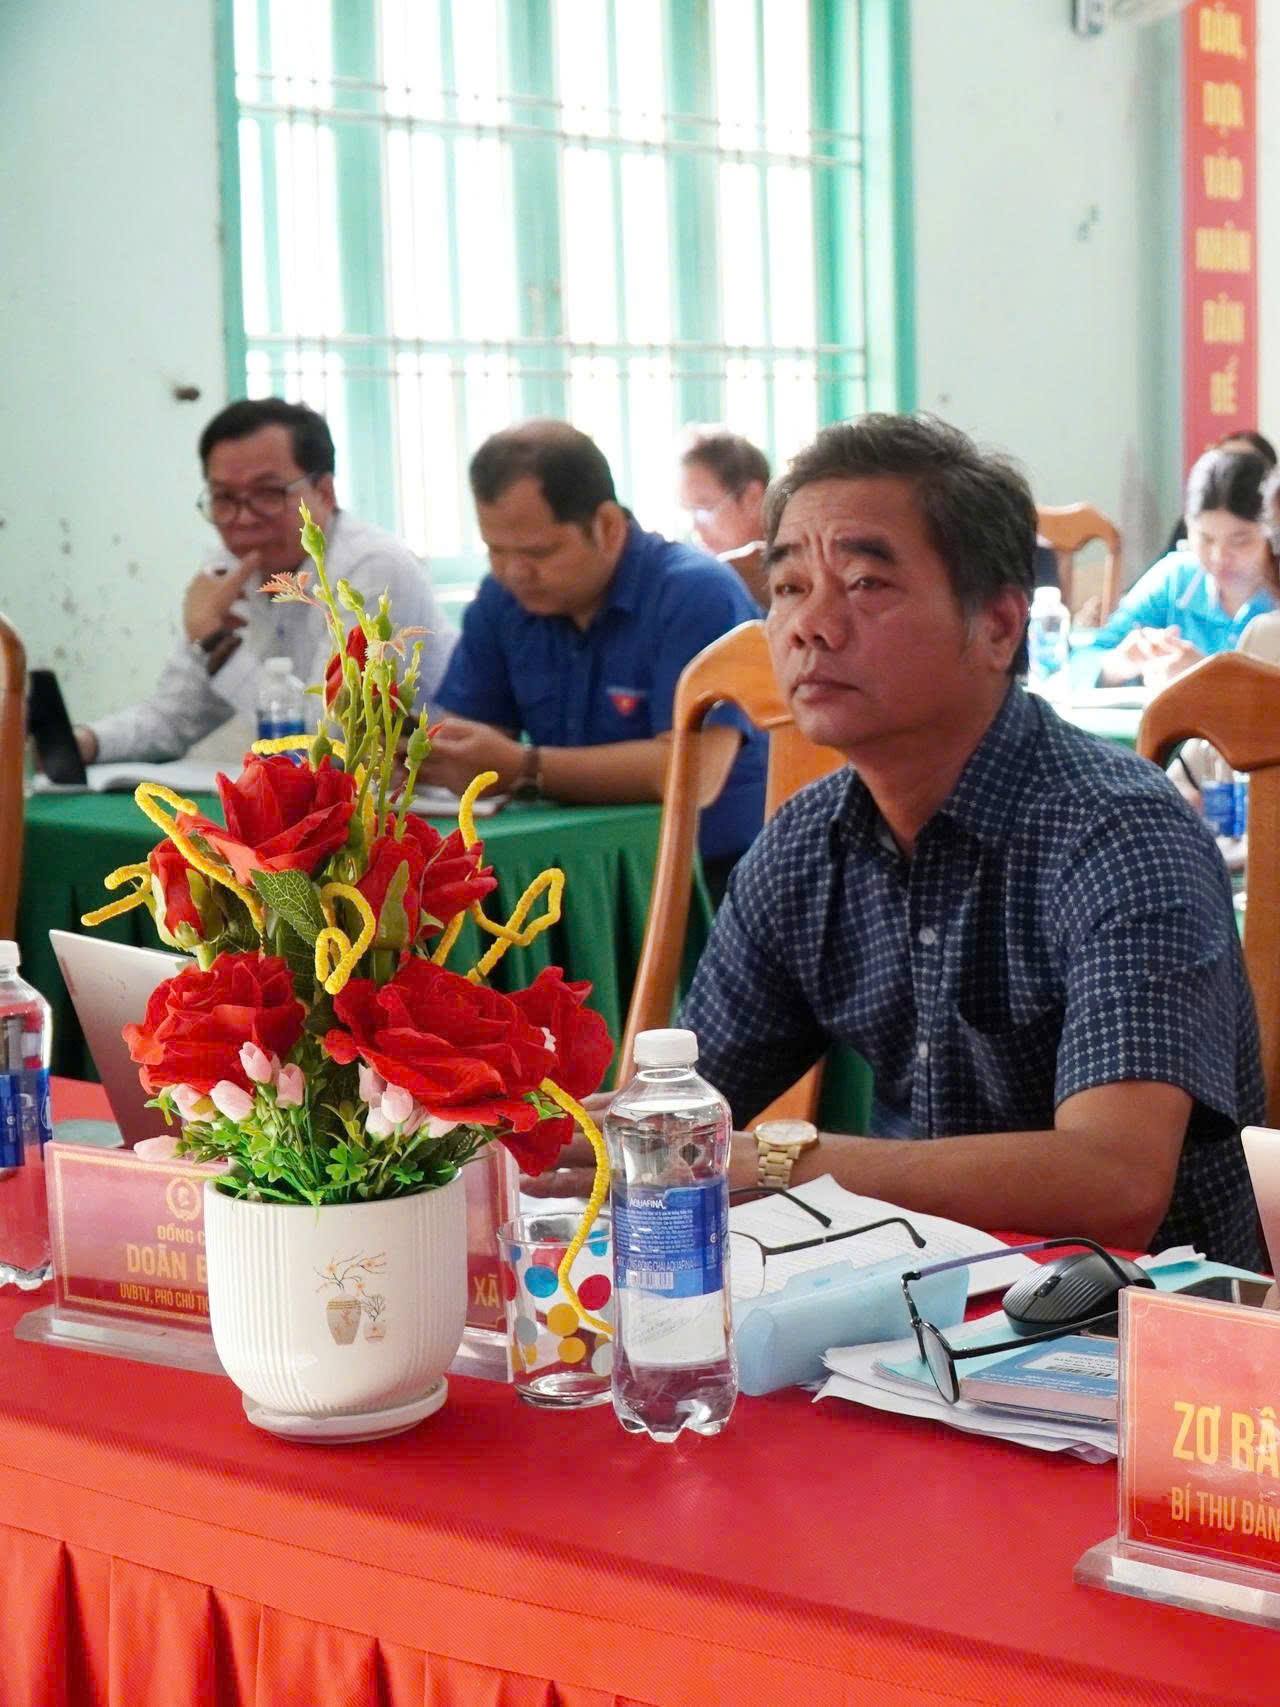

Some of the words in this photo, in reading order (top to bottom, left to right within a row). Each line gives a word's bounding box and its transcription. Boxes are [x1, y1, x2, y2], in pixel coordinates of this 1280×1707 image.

[126, 1243, 187, 1281] DOÃN
[473, 1273, 501, 1309] XÃ
[1173, 1401, 1221, 1465] ZƠ
[1171, 1483, 1191, 1523] BÍ
[1197, 1491, 1237, 1532] THƯ
